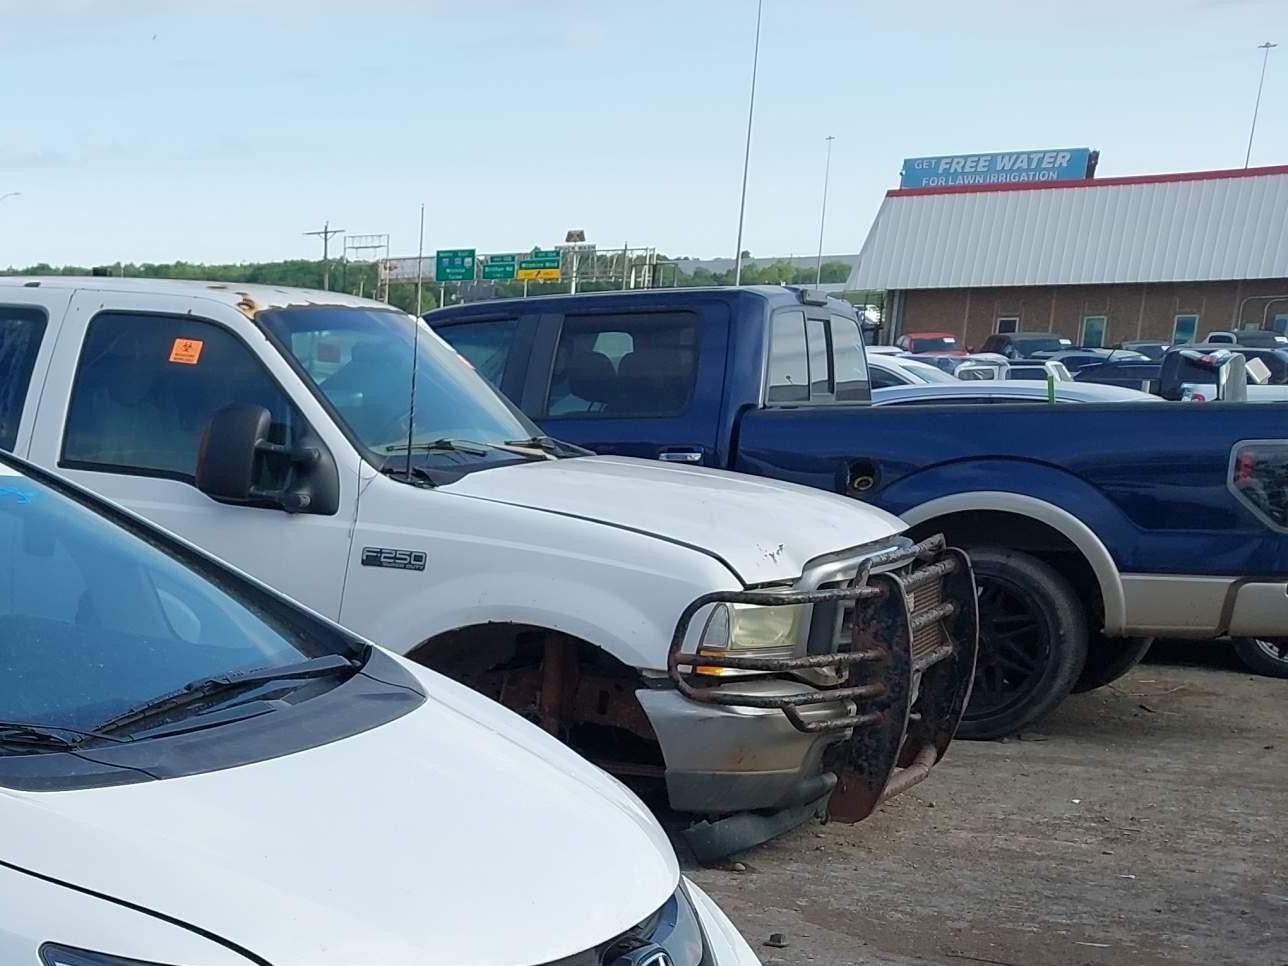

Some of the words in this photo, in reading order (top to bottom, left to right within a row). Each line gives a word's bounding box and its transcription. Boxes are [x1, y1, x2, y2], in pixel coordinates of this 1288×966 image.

[914, 159, 937, 169] GET
[938, 155, 991, 173] FREE
[996, 150, 1071, 171] WATER
[922, 176, 946, 187] FOR
[949, 175, 983, 186] LAWN
[986, 170, 1058, 184] IRRIGATION
